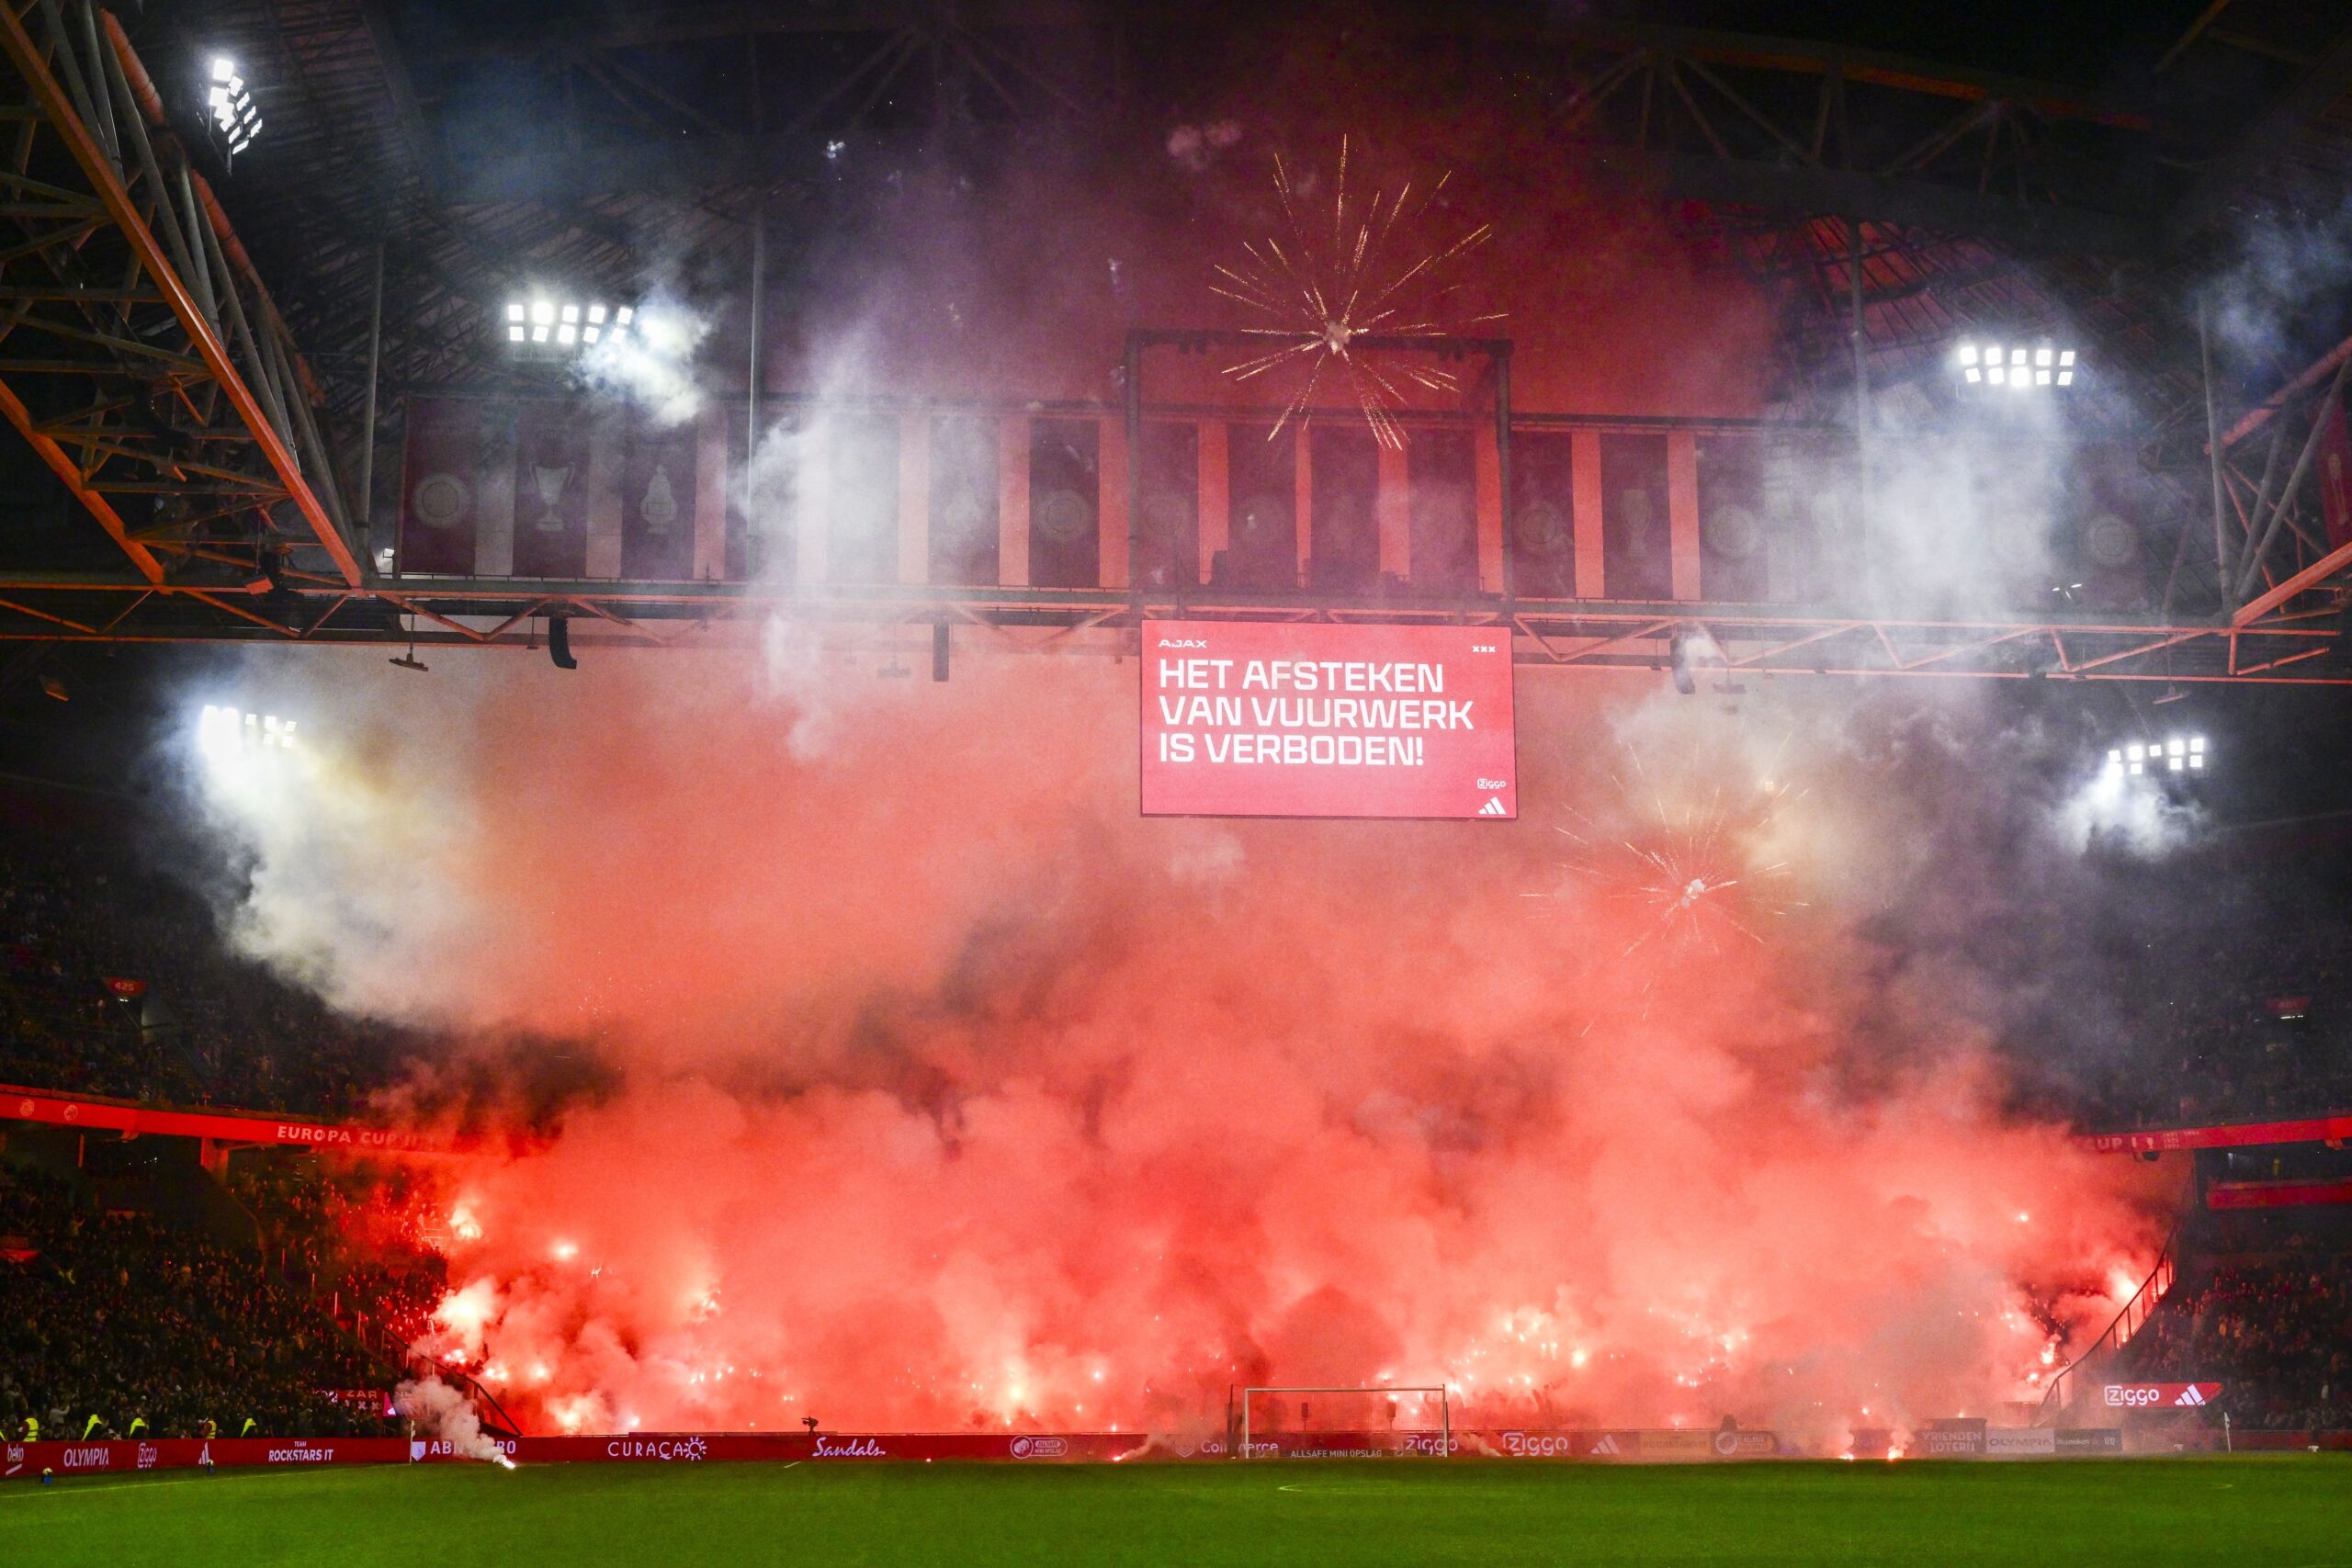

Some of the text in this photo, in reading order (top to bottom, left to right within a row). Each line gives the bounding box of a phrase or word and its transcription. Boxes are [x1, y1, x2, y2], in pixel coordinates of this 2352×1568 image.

[1158, 639, 1207, 648] AJAX
[1159, 659, 1443, 693] HET AFSTEKEN
[1159, 695, 1475, 730] VAN VUURWERK
[1159, 732, 1424, 766] IS VERBODEN!
[114, 982, 134, 991] 425
[277, 1125, 351, 1143] EUROPA
[360, 1131, 398, 1145] CUP
[2104, 1385, 2159, 1405] Ziggo
[7, 1443, 24, 1462] beko
[812, 1437, 886, 1457] Sandals
[1989, 1438, 2052, 1447] OLYMPIA
[63, 1447, 109, 1467] OLYMPIA
[268, 1449, 334, 1462] ROCKSTARS IT
[1290, 1450, 1382, 1458] ALLSAFE MINI OPSLAG
